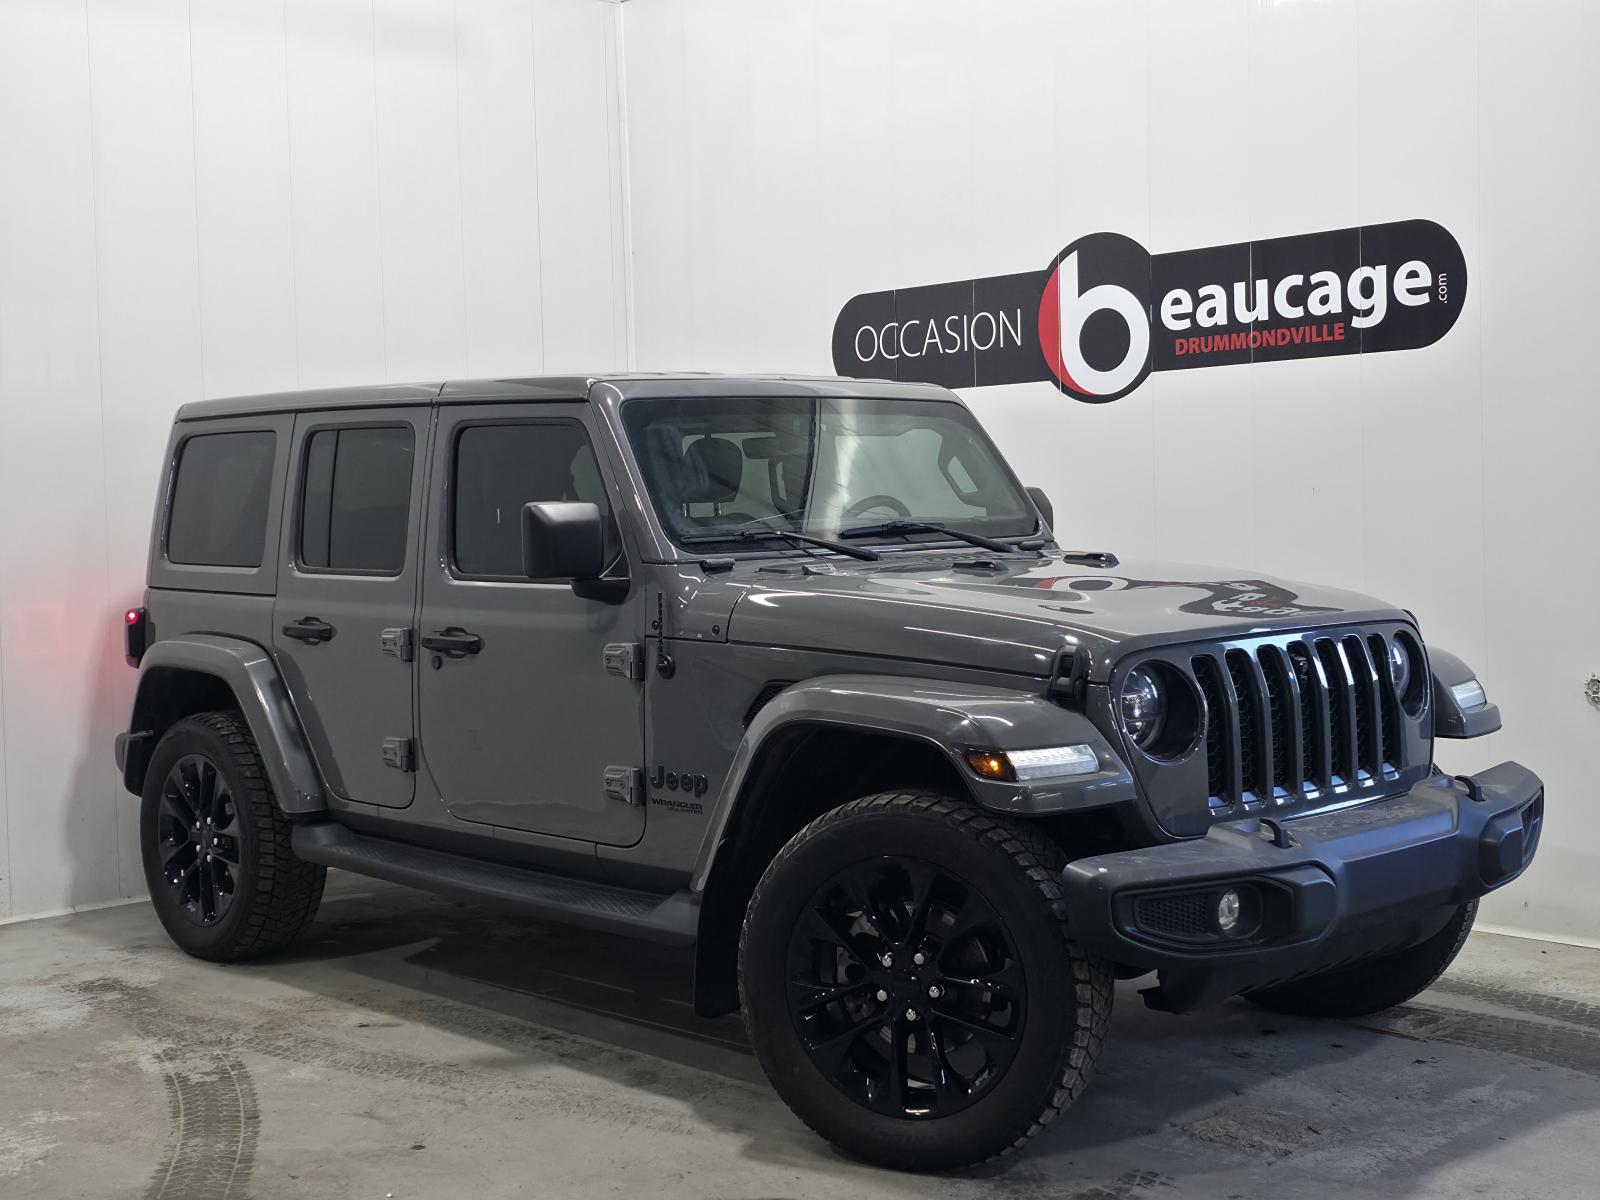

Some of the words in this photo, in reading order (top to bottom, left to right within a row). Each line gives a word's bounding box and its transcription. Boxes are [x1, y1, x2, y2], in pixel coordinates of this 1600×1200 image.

[855, 308, 1022, 362] OCCASION
[1438, 273, 1448, 304] .com
[1175, 322, 1346, 356] DRUMMONDVILLE
[650, 765, 708, 798] Jeep
[651, 798, 703, 810] WRANGLER
